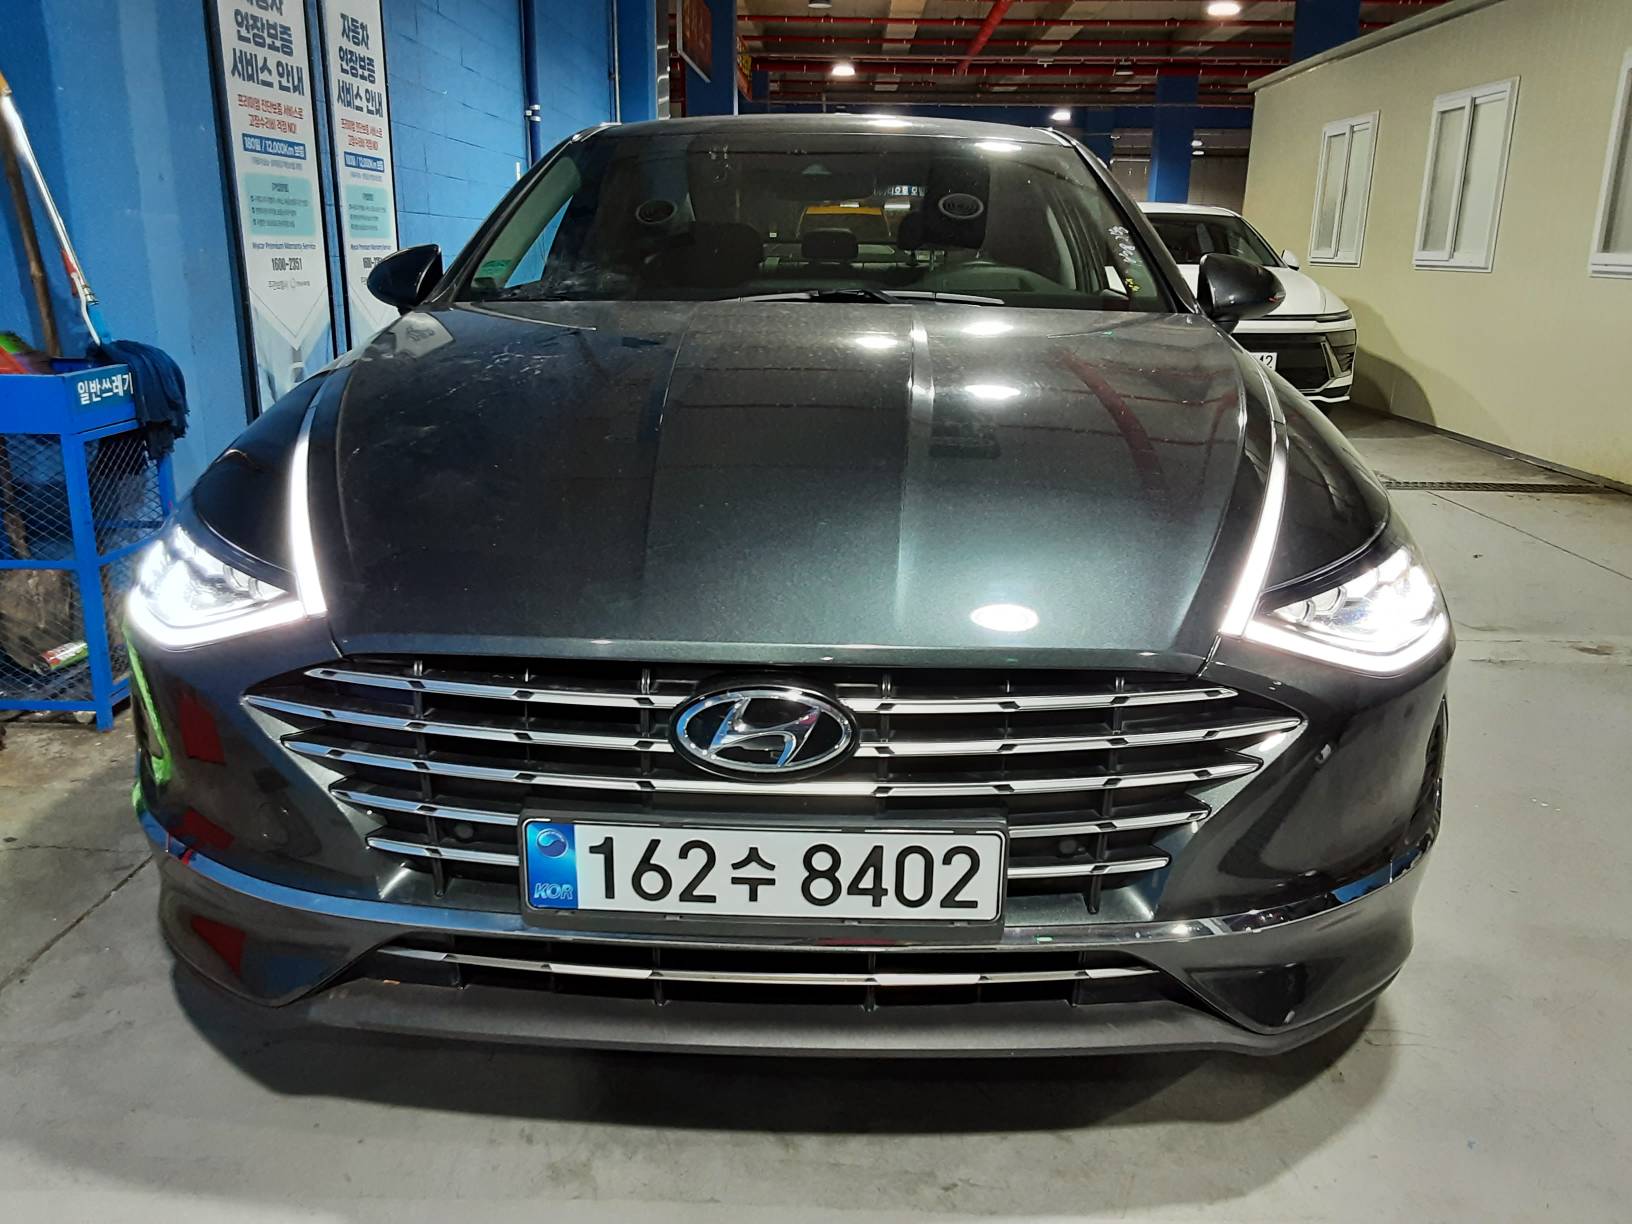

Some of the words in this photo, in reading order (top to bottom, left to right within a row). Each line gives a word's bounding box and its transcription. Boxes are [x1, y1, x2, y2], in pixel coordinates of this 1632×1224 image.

[234, 8, 293, 57] 연장보증
[340, 13, 369, 50] 자동차
[231, 48, 273, 88] 서비스
[276, 60, 304, 96] 안내
[338, 45, 376, 84] 연장보증
[337, 79, 363, 112] 서비스
[365, 88, 383, 118] 안내
[78, 372, 133, 405] 일반쓰레기
[534, 883, 573, 900] KOR
[589, 836, 776, 903] 162수
[801, 843, 980, 909] 8402
